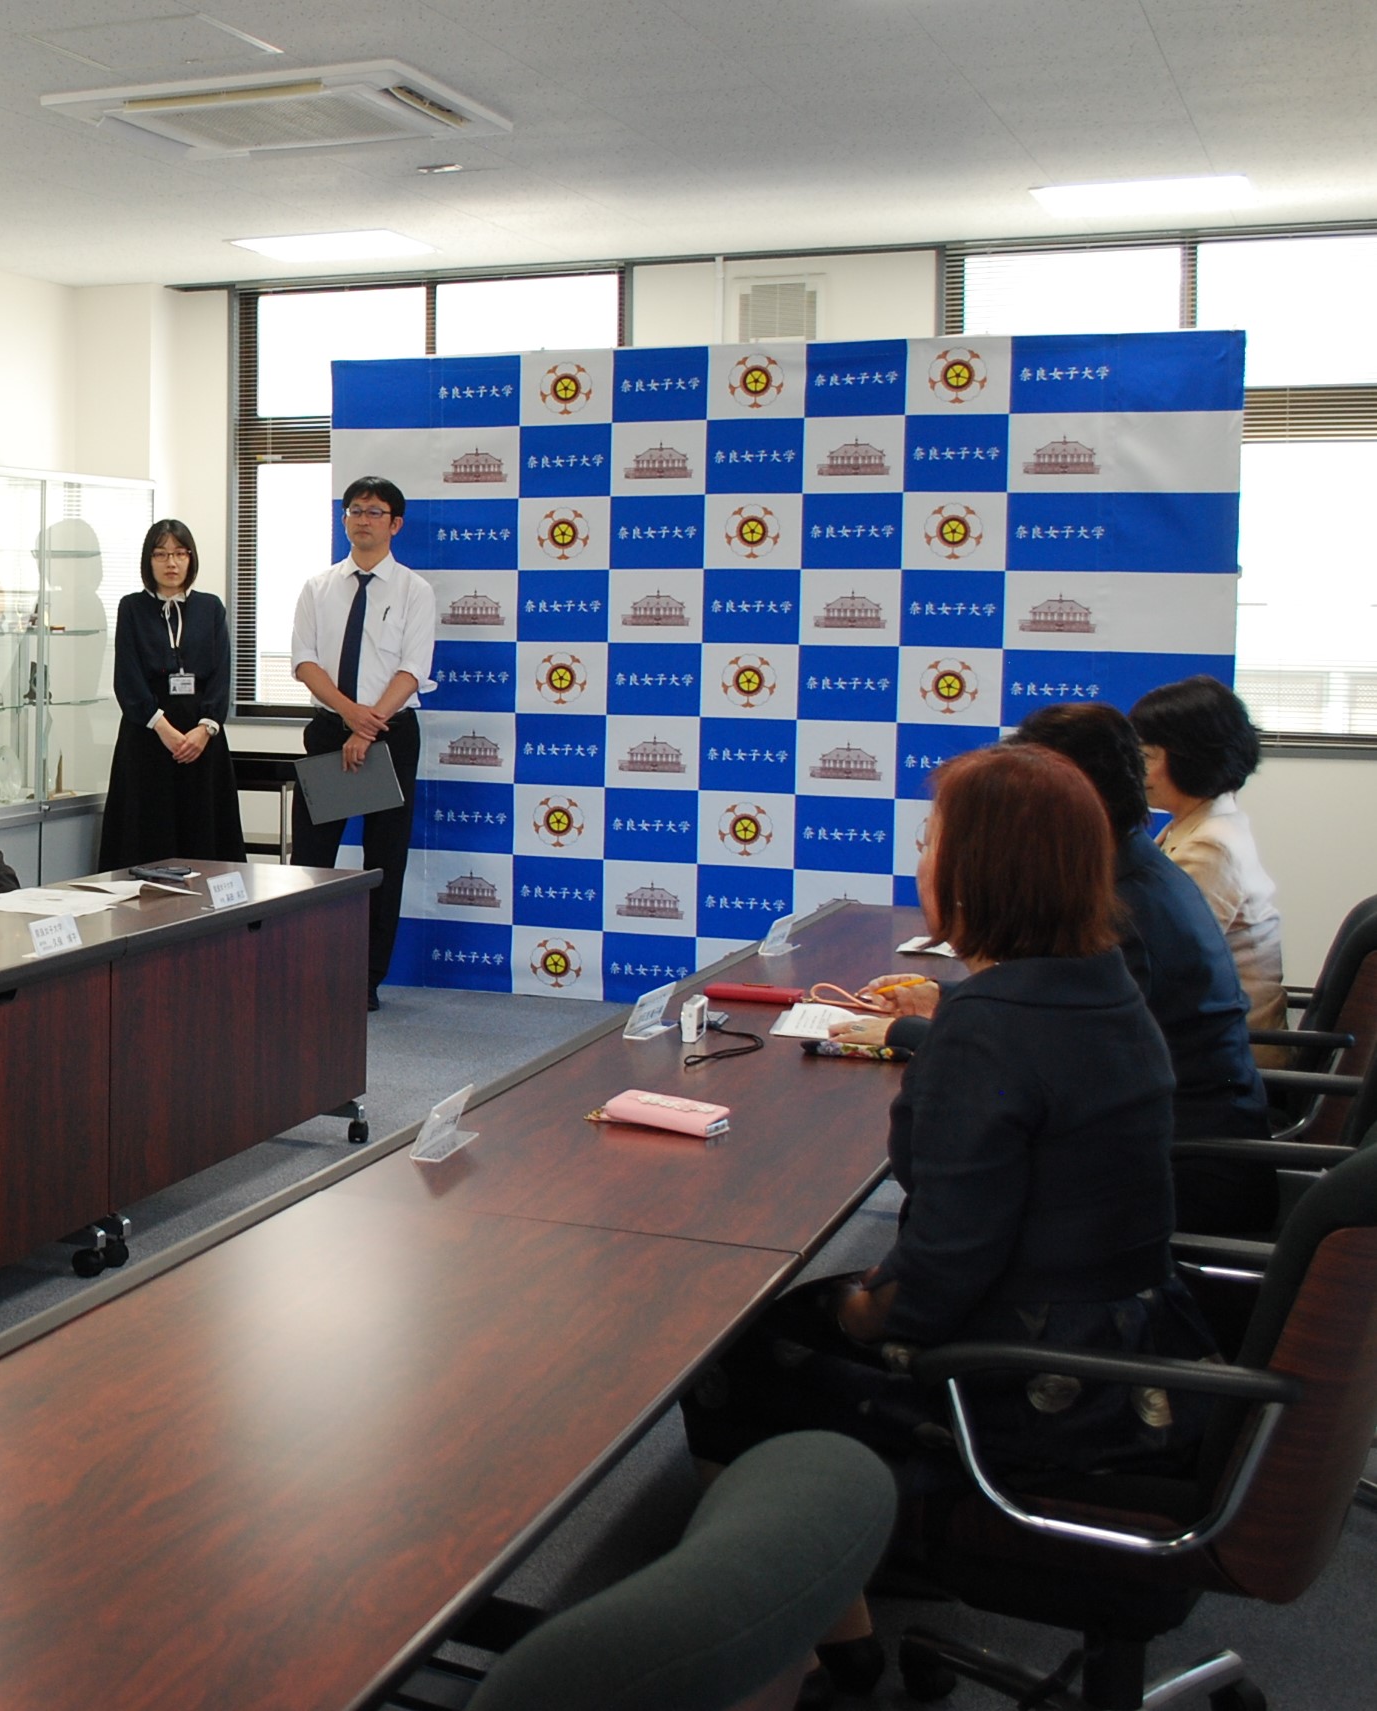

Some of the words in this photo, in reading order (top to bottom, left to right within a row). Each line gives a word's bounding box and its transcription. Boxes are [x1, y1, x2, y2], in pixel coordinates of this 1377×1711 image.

[814, 370, 899, 387] 奈良女子大学
[1019, 365, 1110, 382] 奈良女子大学
[438, 384, 513, 400] 奈良女子大学
[620, 377, 700, 393] 奈良女子大学
[713, 449, 796, 464] 奈良女子大学
[913, 446, 1000, 461] 奈良女子大学
[527, 454, 604, 469] 奈良女子大学
[436, 528, 511, 541] 奈良女子大学
[618, 525, 697, 540] 奈良女子大学
[810, 524, 895, 539] 奈良女子大学
[1015, 525, 1105, 539] 奈良女子大学
[525, 599, 602, 613] 奈良女子大学
[711, 599, 793, 614] 奈良女子大学
[909, 601, 996, 617] 奈良女子大学
[435, 670, 509, 683] 奈良女子大学
[615, 672, 694, 687] 奈良女子大学
[806, 676, 890, 691] 奈良女子大学
[1010, 681, 1100, 698] 奈良女子大学
[523, 742, 598, 757] 奈良女子大学
[708, 747, 788, 763] 奈良女子大学
[434, 809, 507, 825] 奈良女子大学
[612, 818, 691, 833] 奈良女子大学
[802, 826, 886, 843] 奈良女子大学
[520, 884, 596, 901] 奈良女子大学
[705, 895, 786, 912] 奈良女子大学
[431, 948, 504, 965] 奈良女子大学
[609, 962, 688, 979] 奈良女子大学
